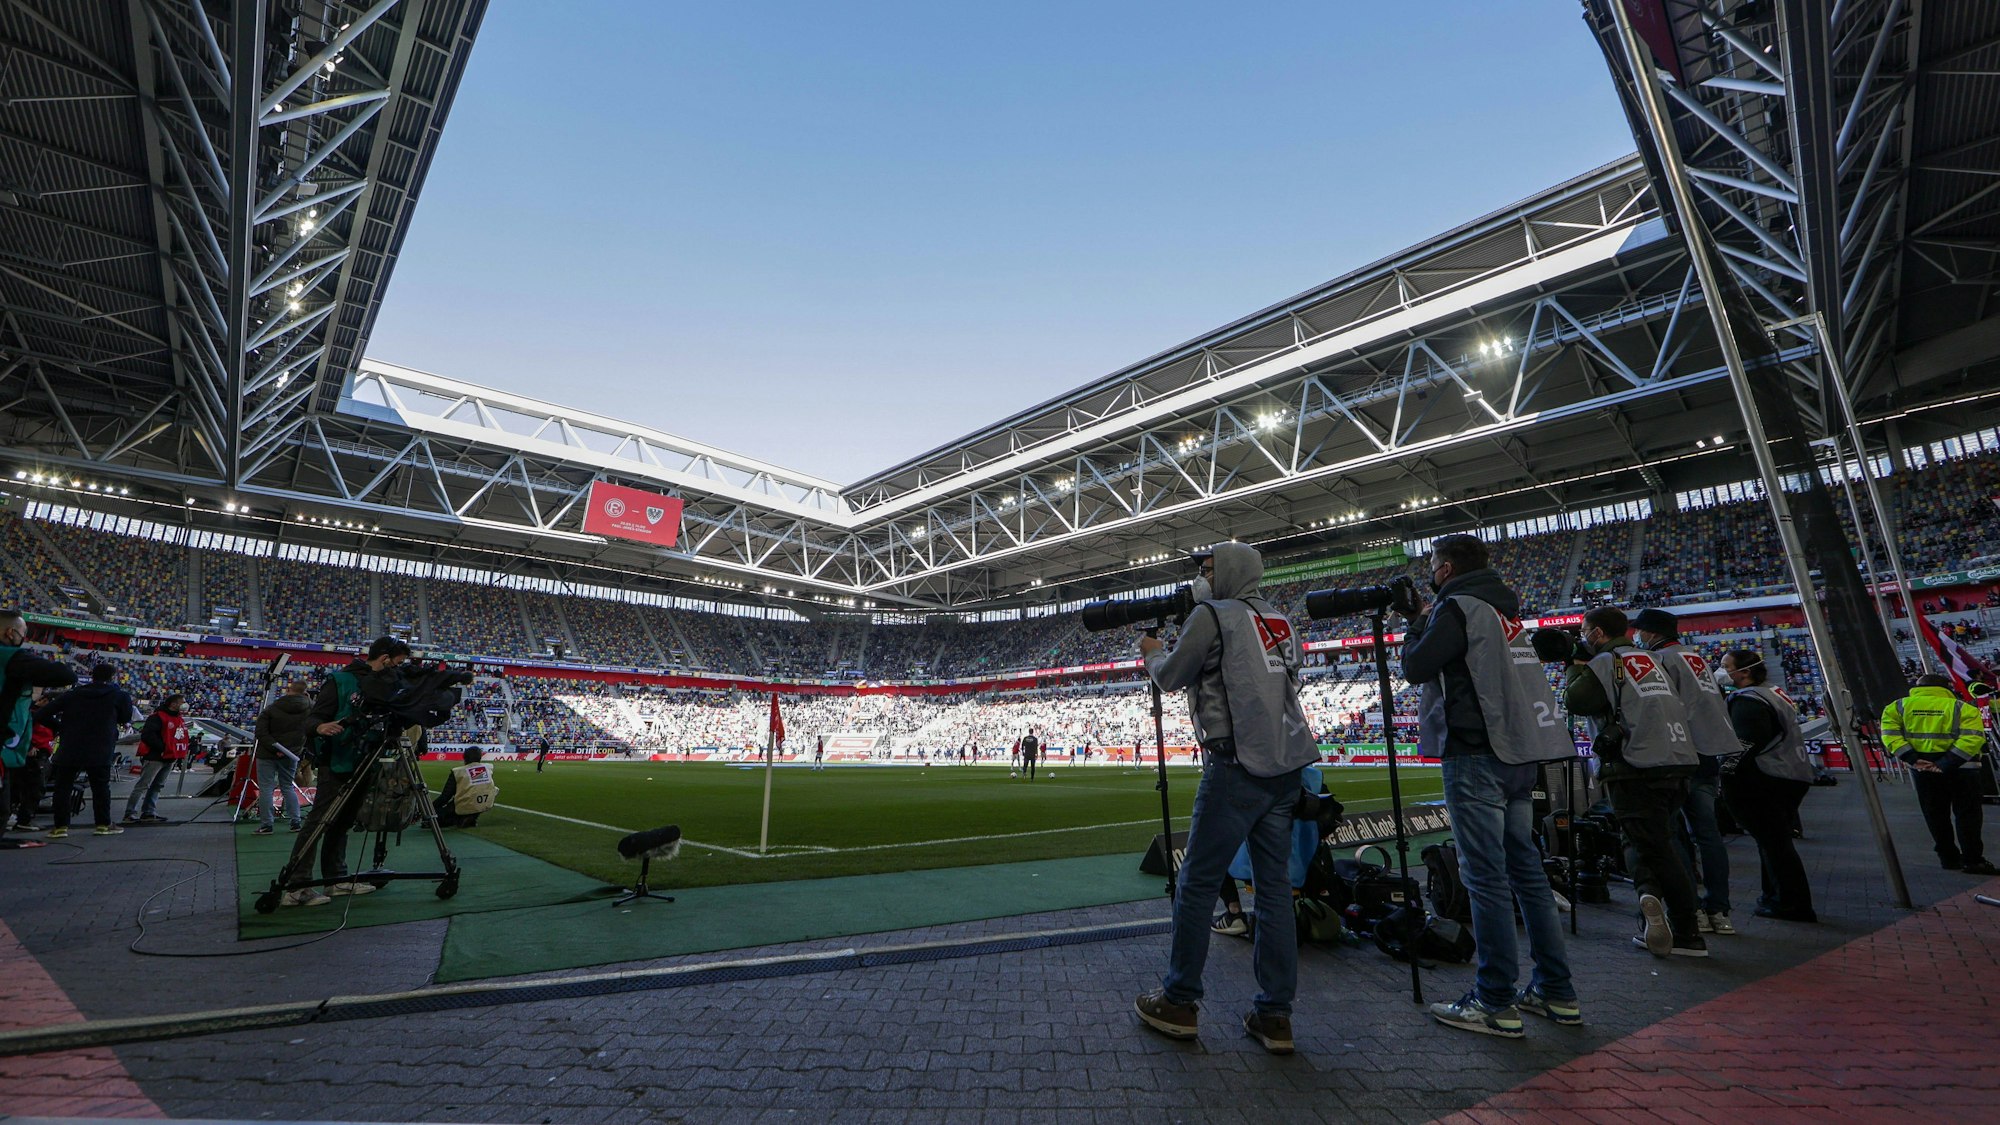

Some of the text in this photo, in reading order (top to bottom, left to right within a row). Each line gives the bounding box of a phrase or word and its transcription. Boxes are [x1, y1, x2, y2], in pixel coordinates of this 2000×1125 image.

[1262, 566, 1296, 577] erstützung
[1296, 563, 1308, 572] von
[1308, 560, 1323, 572] ganz
[1258, 566, 1350, 588] adtwerke Düsseldorf
[1923, 574, 1958, 586] Carlsberg
[1566, 616, 1581, 624] AUS
[1344, 638, 1362, 646] ALLES
[1347, 746, 1412, 757] Düsselorf
[476, 794, 489, 804] 07
[1410, 815, 1429, 831] me
[1425, 809, 1445, 829] and
[1335, 818, 1360, 843] and
[1357, 817, 1375, 840] all
[1368, 814, 1398, 838] hotel
